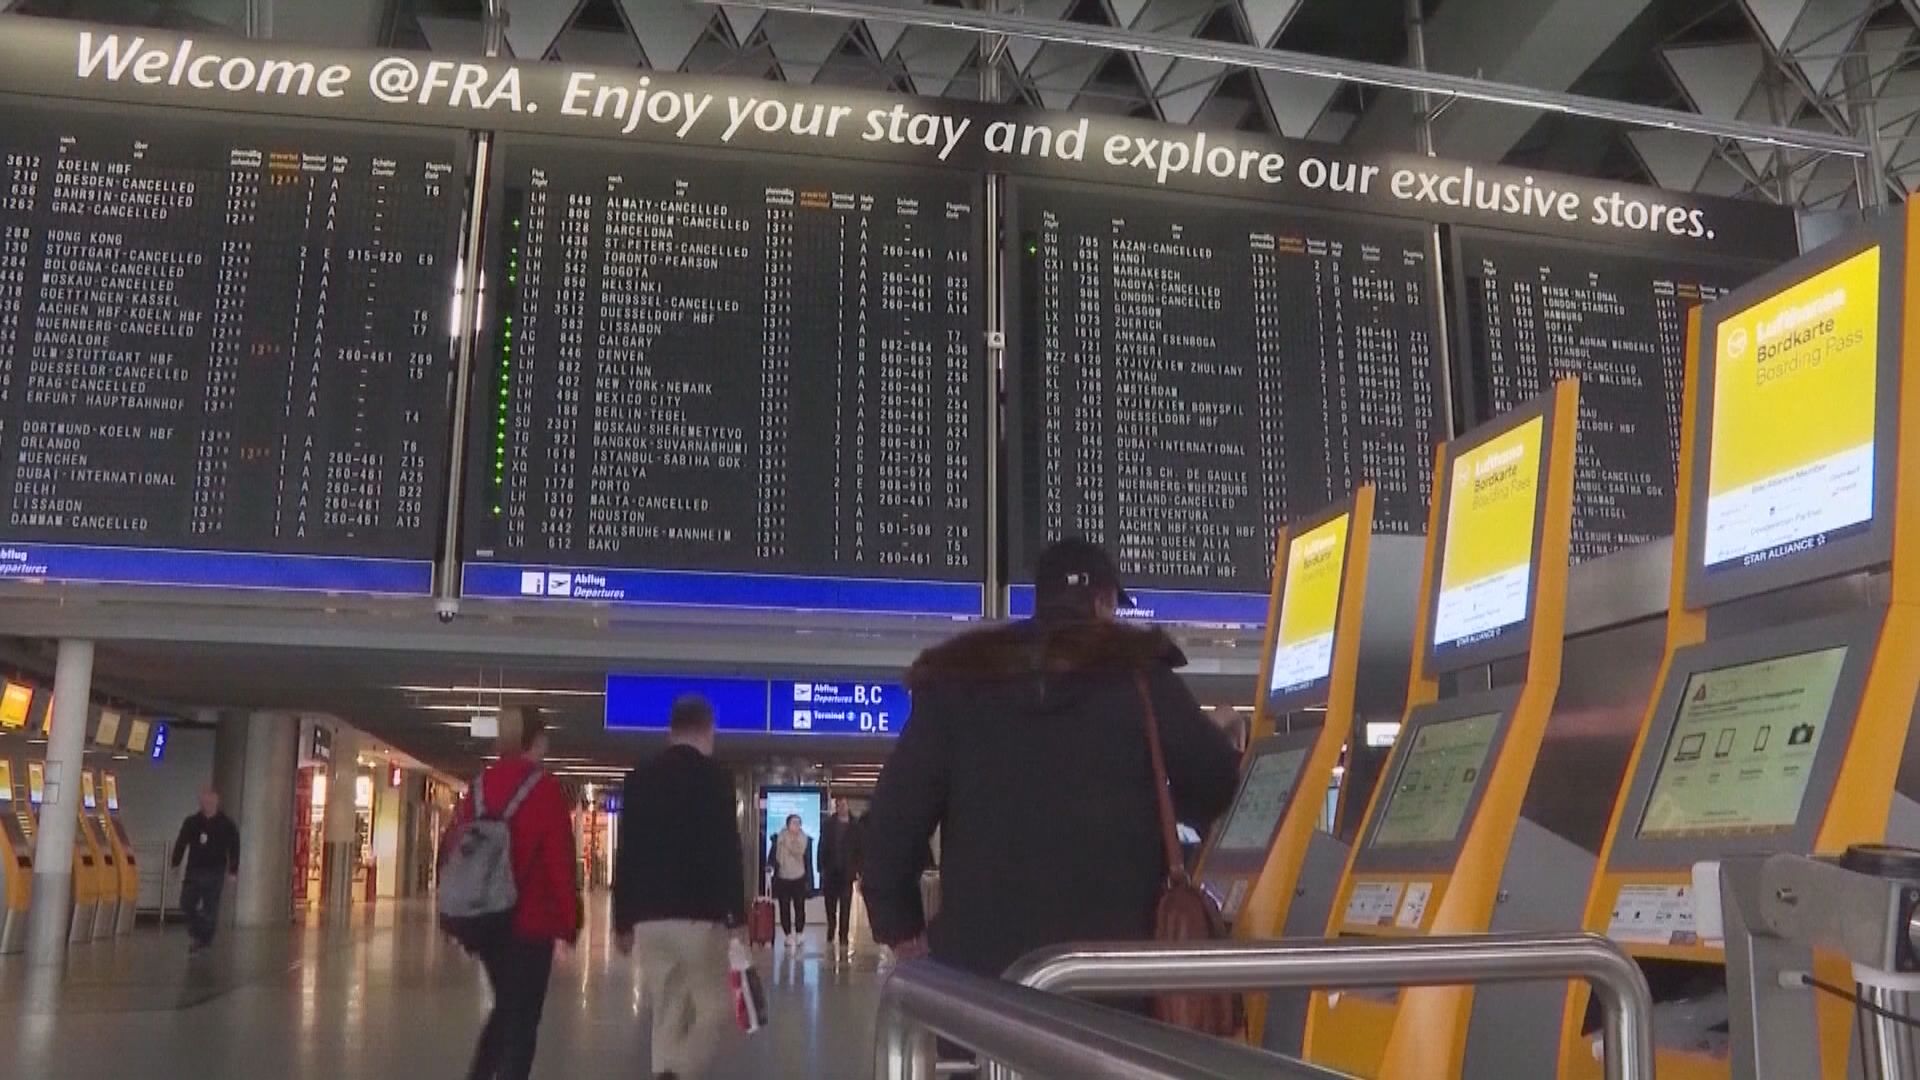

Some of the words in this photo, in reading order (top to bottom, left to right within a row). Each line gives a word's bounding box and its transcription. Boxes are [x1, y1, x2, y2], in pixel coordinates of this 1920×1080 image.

[77, 32, 351, 98] Welcome
[369, 57, 537, 114] @FRA.
[560, 72, 713, 138] Enjoy
[721, 95, 852, 142] your
[862, 108, 970, 161] stay
[984, 118, 1086, 162] and
[1104, 130, 1283, 185] explore
[1299, 157, 1378, 195] our
[1392, 167, 1581, 225] exclusive
[1593, 192, 1714, 239] stores.
[7, 155, 40, 167] 3612
[58, 160, 99, 172] KOELN
[108, 163, 132, 173] HBF
[14, 171, 38, 182] 210
[532, 192, 546, 203] LH
[531, 205, 545, 216] LH
[607, 197, 727, 216] ALMATY-CANCELLED
[529, 219, 544, 229] LH
[607, 211, 749, 231] STOCKHOLM-CANCELLED
[48, 230, 81, 242] HONG
[90, 233, 122, 245] KONG
[528, 232, 543, 243] LH
[606, 224, 673, 238] BARCELONA
[527, 246, 542, 257] LH
[526, 260, 540, 271] LH
[604, 252, 718, 269] TORONTO-PEARSON
[603, 265, 648, 278] BOGOTA
[525, 274, 540, 285] LH
[602, 280, 662, 292] HELSINKI
[524, 288, 539, 299] LH
[39, 303, 88, 315] AACHEN
[179, 308, 203, 321] HBF
[693, 312, 714, 324] HBF
[600, 321, 661, 335] LISSABON
[34, 335, 109, 347] BANGALORE
[600, 336, 652, 348] CALGARY
[1757, 318, 1835, 363] Bordkarte
[150, 352, 173, 365] HBF
[598, 349, 644, 362] DENVER
[599, 364, 650, 376] TALLINN
[28, 376, 146, 393] PRAG-CANCELLED
[596, 378, 620, 390] NEW
[628, 380, 712, 394] YORK-NEWARK
[1116, 383, 1178, 397] AMSTERDAM
[27, 391, 76, 405] ERFURT
[86, 395, 185, 410] HAUPTBAHNHOF
[596, 393, 642, 405] MEXICO
[650, 396, 681, 408] CITY
[595, 406, 687, 422] BERLIN-TEGEL
[150, 427, 173, 440] HBF
[21, 437, 80, 450] ORLANDO
[19, 452, 87, 466] MUENCHEN
[17, 467, 176, 485] DUBAI-INTERNATIONAL
[592, 464, 646, 479] ANTALYA
[1118, 465, 1152, 477] PARIS
[1187, 468, 1199, 479] DE
[1208, 469, 1246, 483] GAULLE
[15, 482, 56, 495] DELHI
[592, 480, 630, 492] PORTO
[13, 498, 82, 511] LISSABON
[590, 494, 708, 512] MALTA-CANCELLED
[590, 509, 645, 522] HOUSTON
[1119, 506, 1208, 521] FUERTEVENTURA
[1119, 520, 1161, 532] AACHEN
[1237, 525, 1255, 537] HBF
[588, 539, 620, 552] BAKU
[1203, 538, 1229, 550] ALIA
[1204, 552, 1230, 564] ALIA
[1744, 550, 1767, 566] STAR
[1768, 537, 1815, 559] ALLIANCE
[1217, 566, 1237, 577] HBF
[574, 573, 605, 586] Abflug
[574, 587, 624, 598] Departures
[814, 683, 838, 694] Abflug
[813, 711, 844, 720] Terminal
